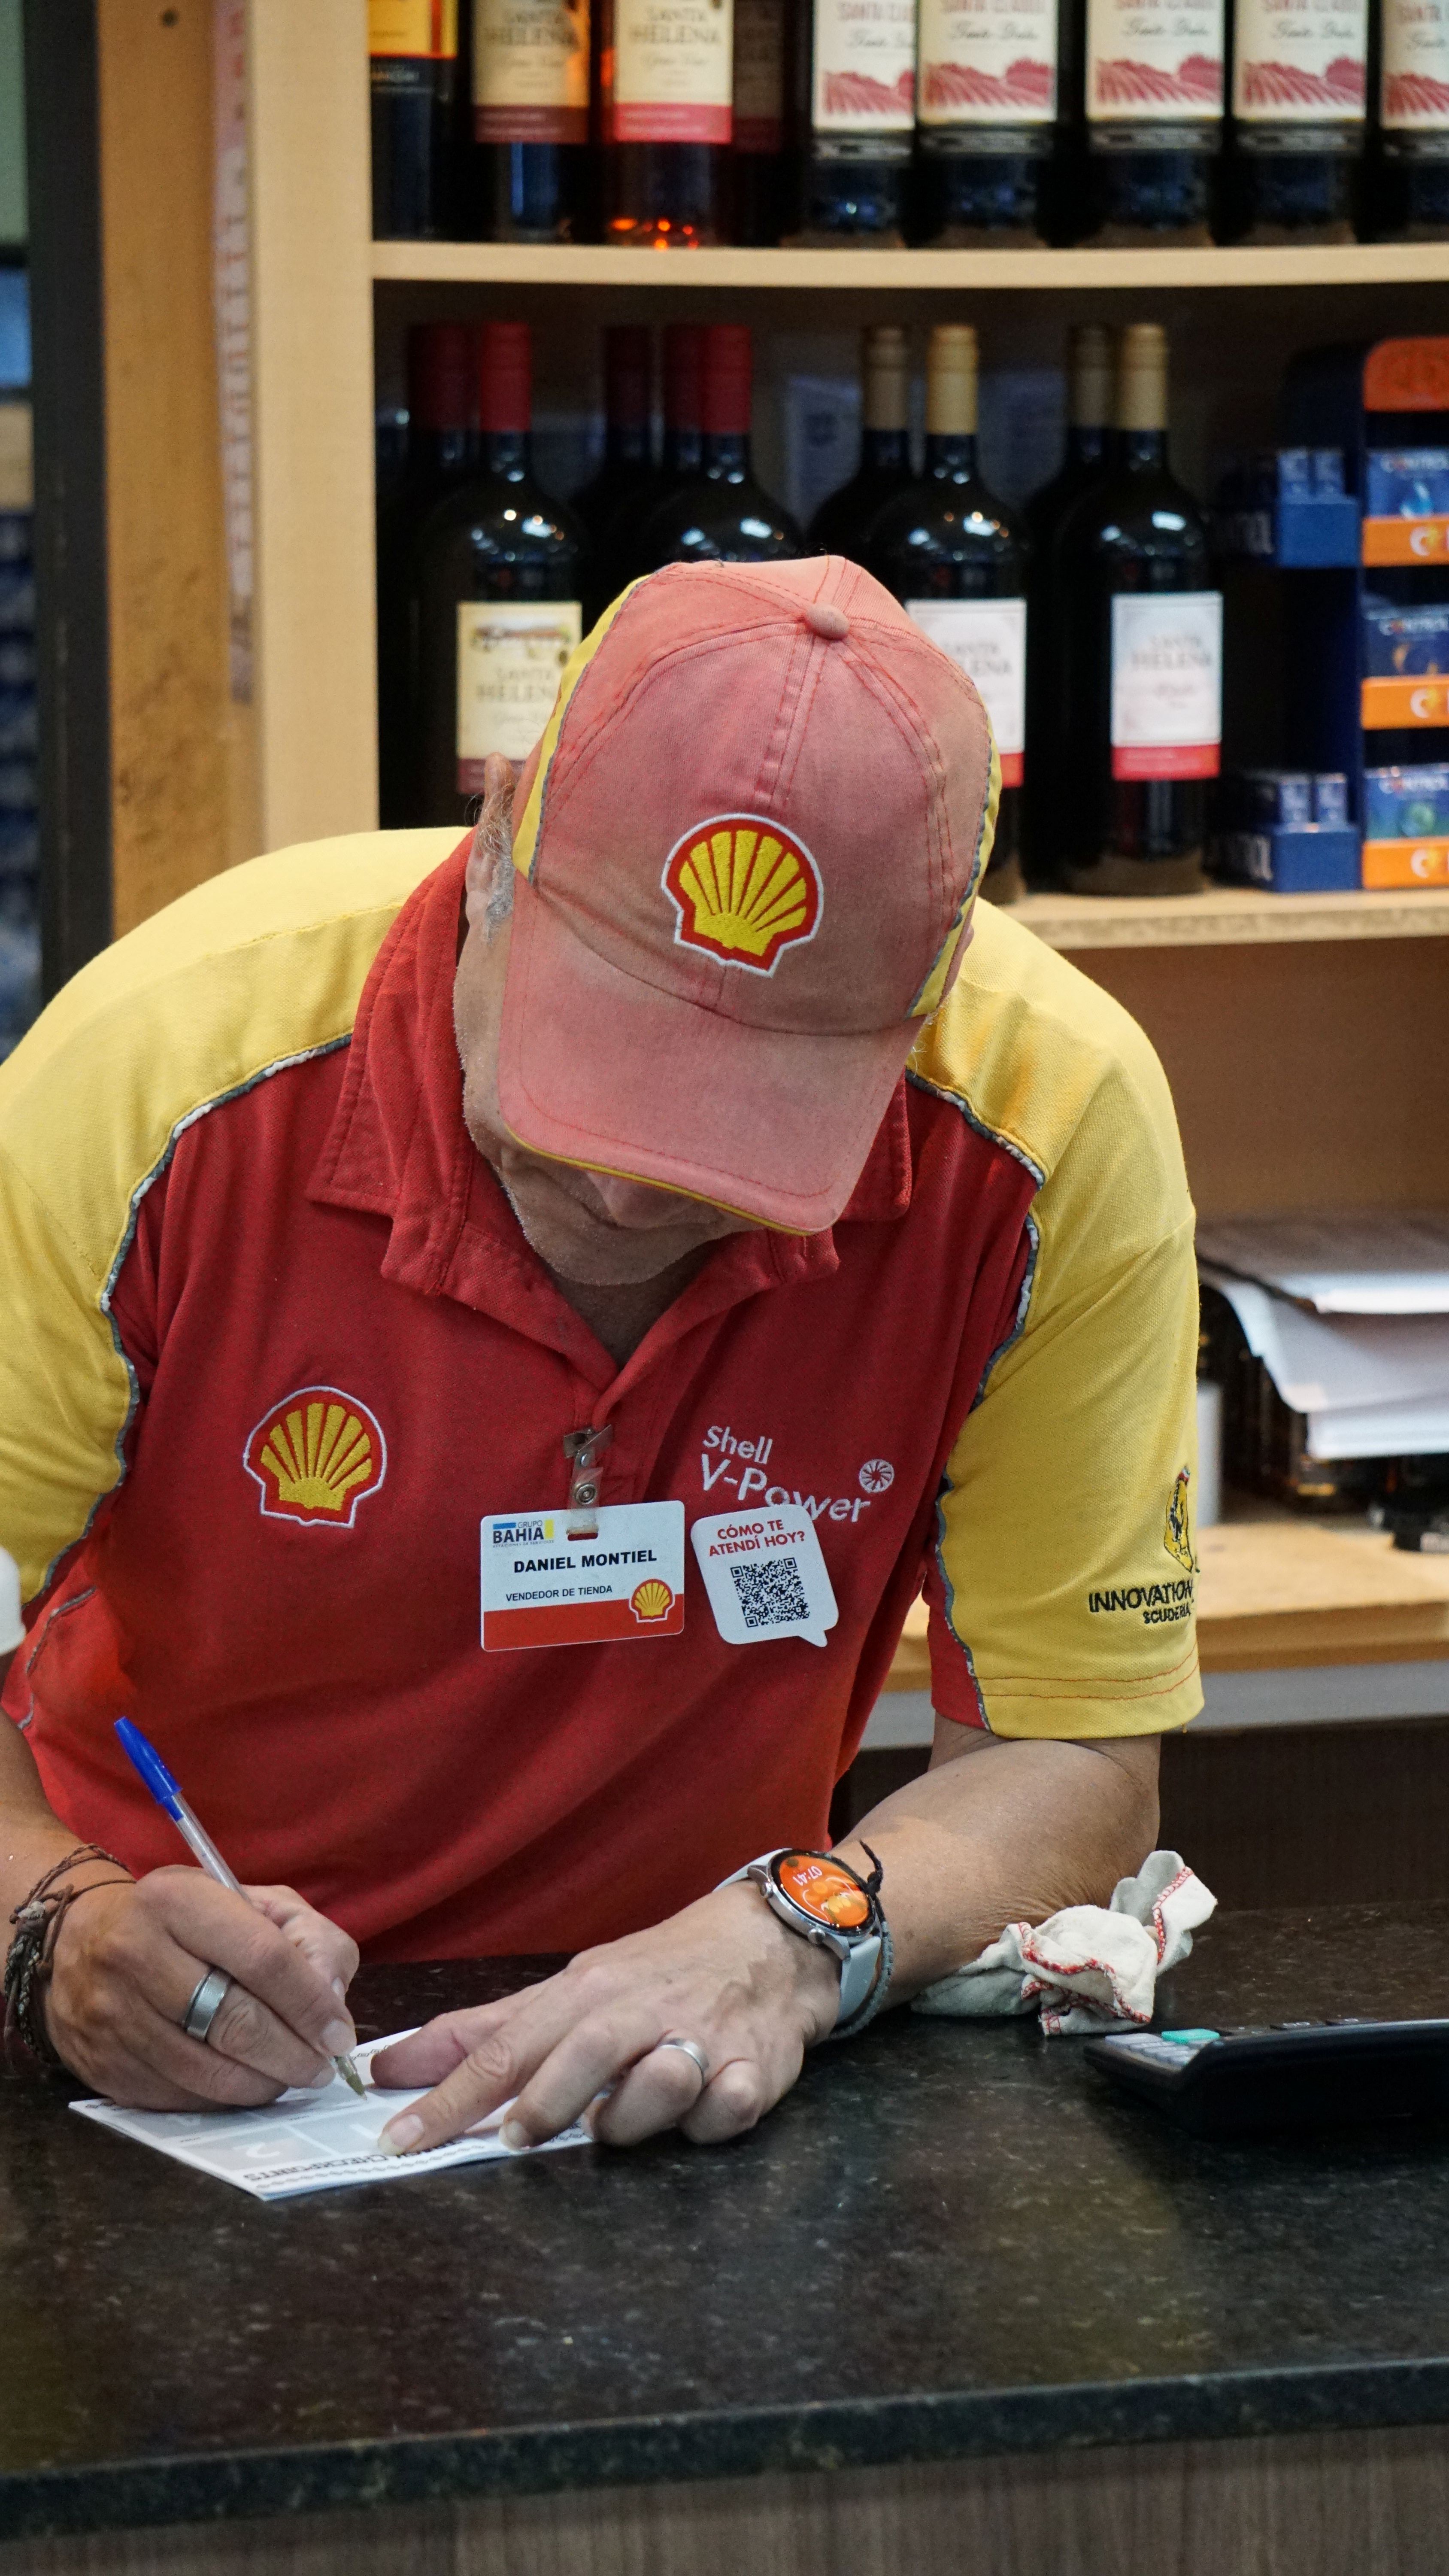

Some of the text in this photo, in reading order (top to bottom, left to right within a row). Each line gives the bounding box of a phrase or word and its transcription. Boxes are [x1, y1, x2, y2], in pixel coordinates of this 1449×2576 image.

[703, 1425, 772, 1464] Shell
[701, 1454, 870, 1522] V-Power
[493, 1527, 544, 1543] BAHIA
[717, 1519, 784, 1540] CÓMO TE
[709, 1531, 805, 1557] ATENDÍ HOY?
[514, 1549, 657, 1573] DANIEL MONTIEL
[506, 1585, 612, 1601] VENDEDOR DE TIENDA
[1089, 1579, 1194, 1613] INNOVATION
[1142, 1607, 1191, 1624] SCUDERIA
